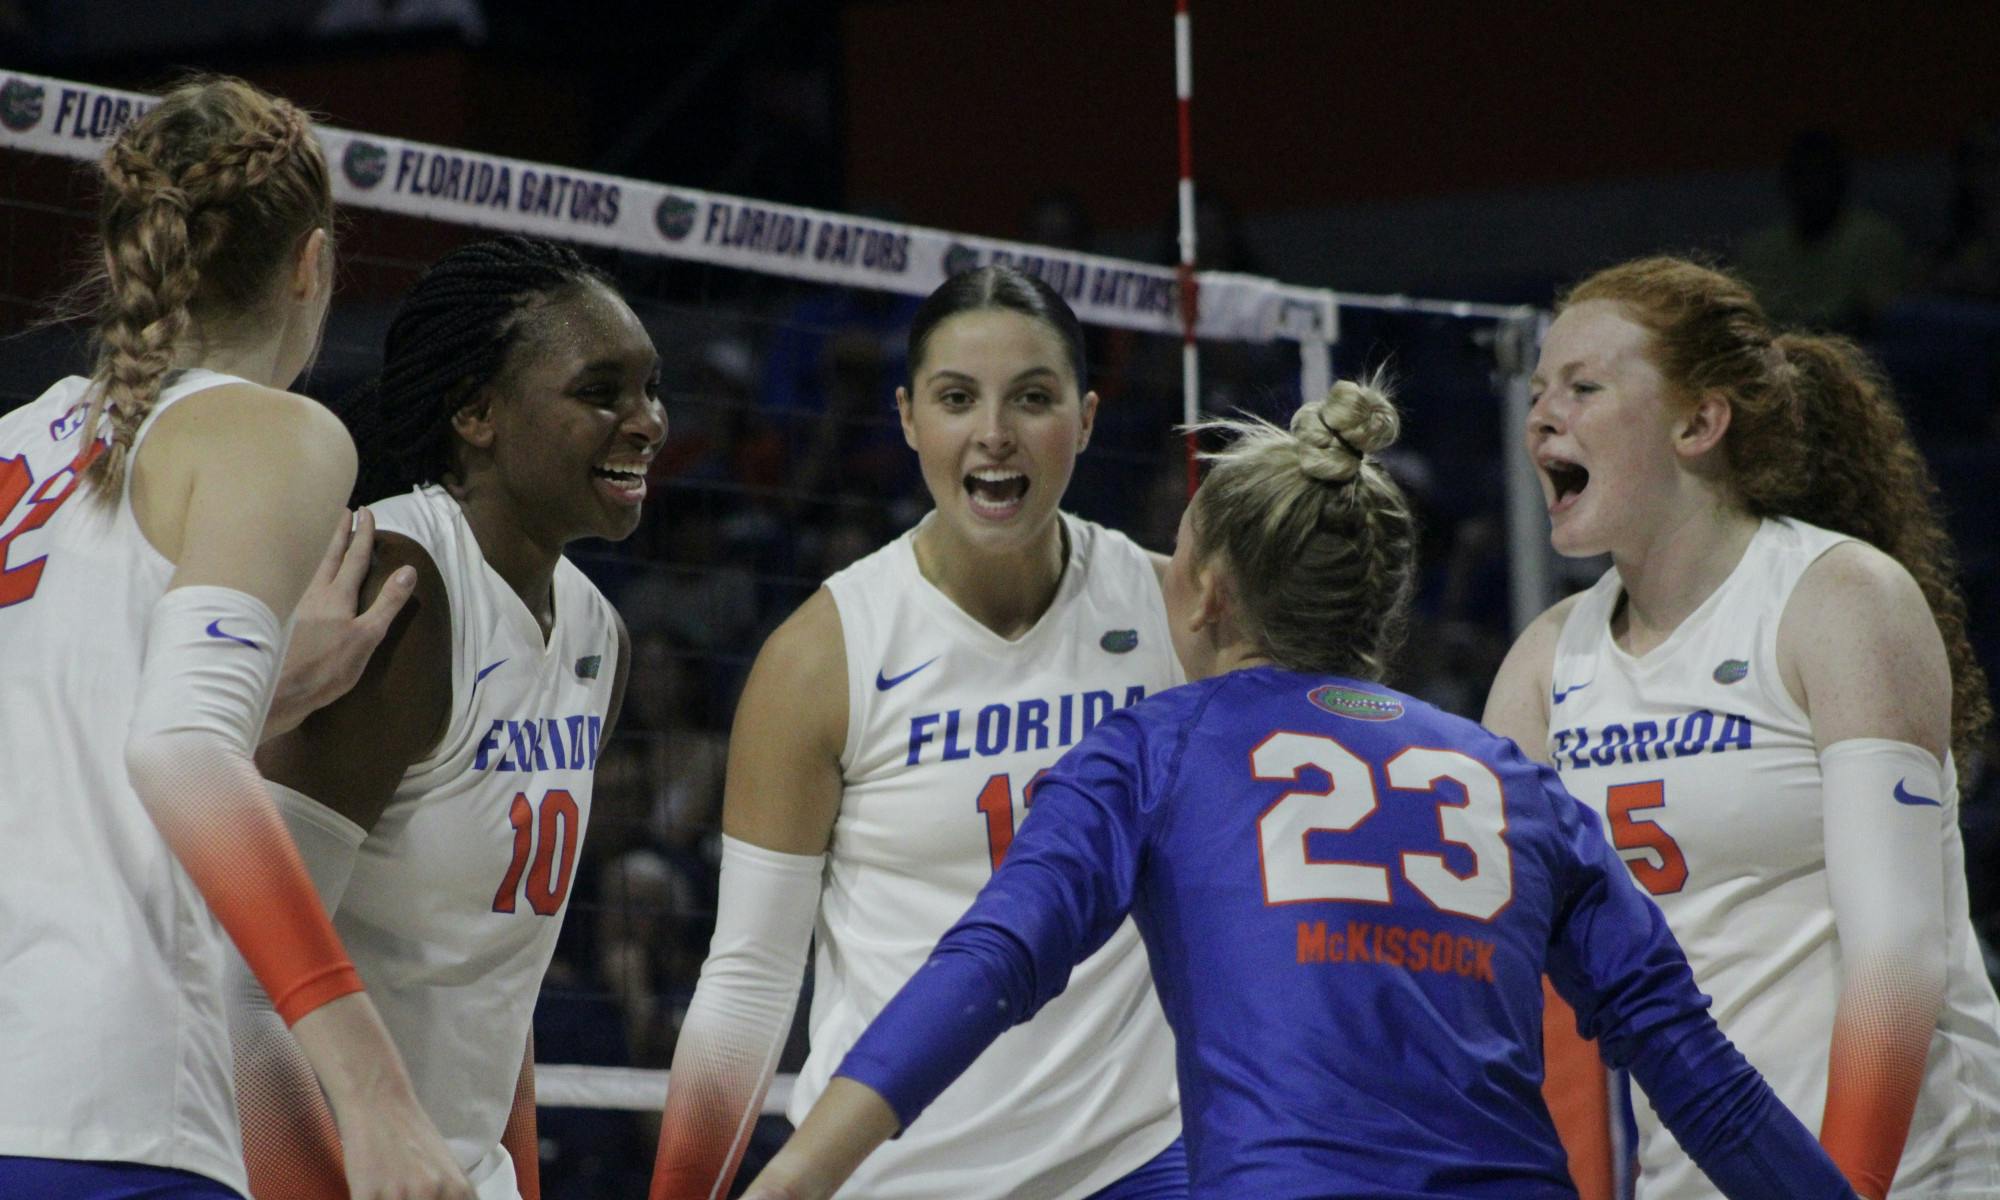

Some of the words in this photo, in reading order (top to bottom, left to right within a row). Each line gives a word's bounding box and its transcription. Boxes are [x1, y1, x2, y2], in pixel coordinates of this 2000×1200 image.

[395, 148, 511, 211] FLORIDA
[518, 169, 622, 226] GATORS
[704, 203, 811, 257] FLORIDA
[815, 220, 911, 272] GATORS
[1552, 708, 1752, 772] FLORIDA
[492, 789, 579, 917] 10
[976, 767, 1052, 874] 1
[1249, 729, 1515, 924] 23
[1606, 778, 1690, 896] 5
[1296, 921, 1495, 983] McKISSOCK
